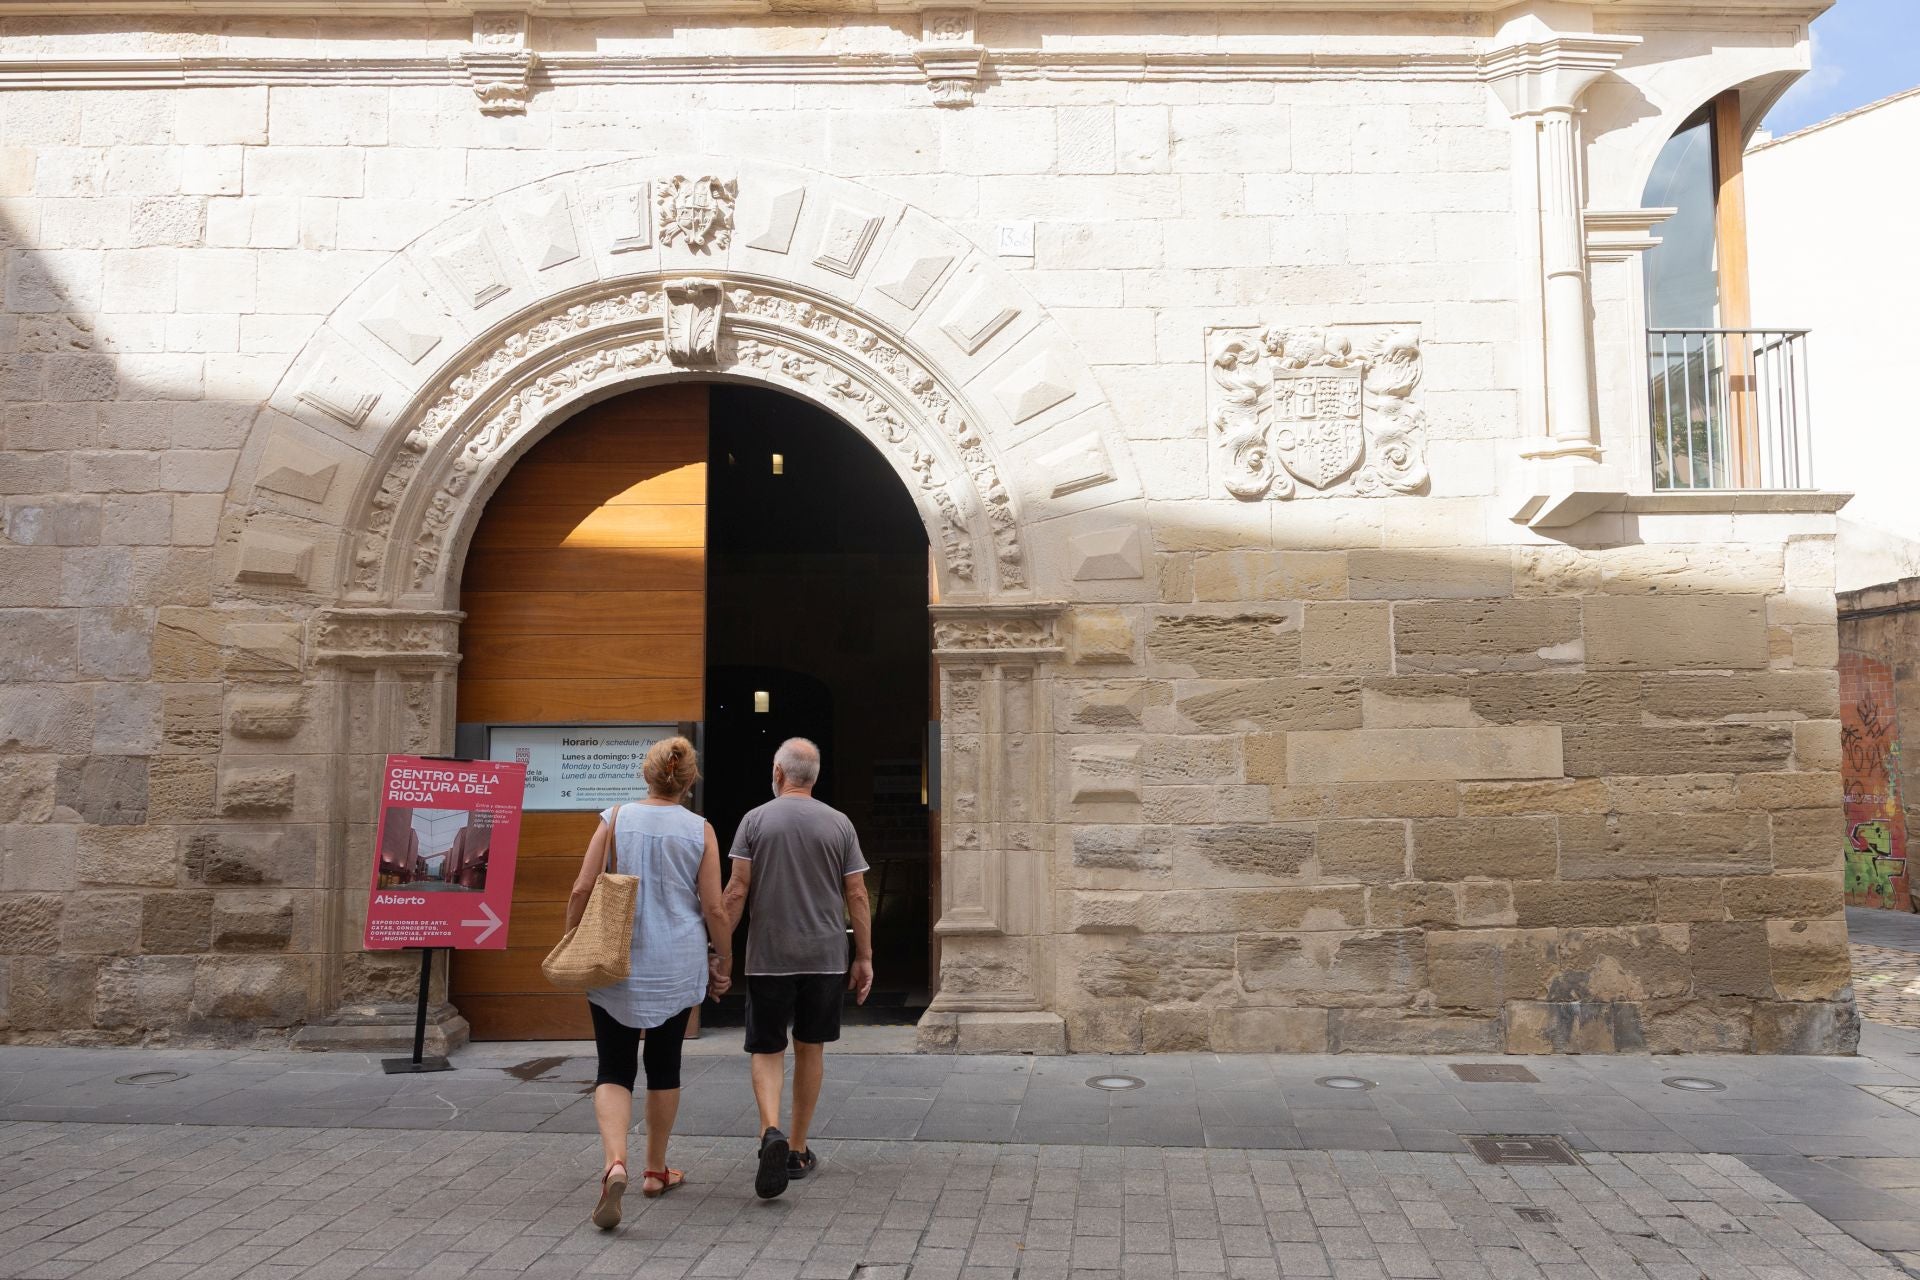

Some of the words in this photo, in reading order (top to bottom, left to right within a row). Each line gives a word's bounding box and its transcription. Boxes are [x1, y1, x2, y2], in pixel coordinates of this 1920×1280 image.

[562, 738, 598, 746] Horario
[593, 753, 630, 762] domingo:
[562, 762, 591, 770] Monday
[602, 762, 630, 770] Sunday
[391, 768, 454, 782] CENTRO
[458, 772, 478, 784] DE
[482, 774, 500, 784] LA
[390, 779, 460, 793] CULTURA
[464, 784, 492, 794] DEL
[388, 790, 434, 802] RIOJA
[374, 894, 426, 905] Abierto
